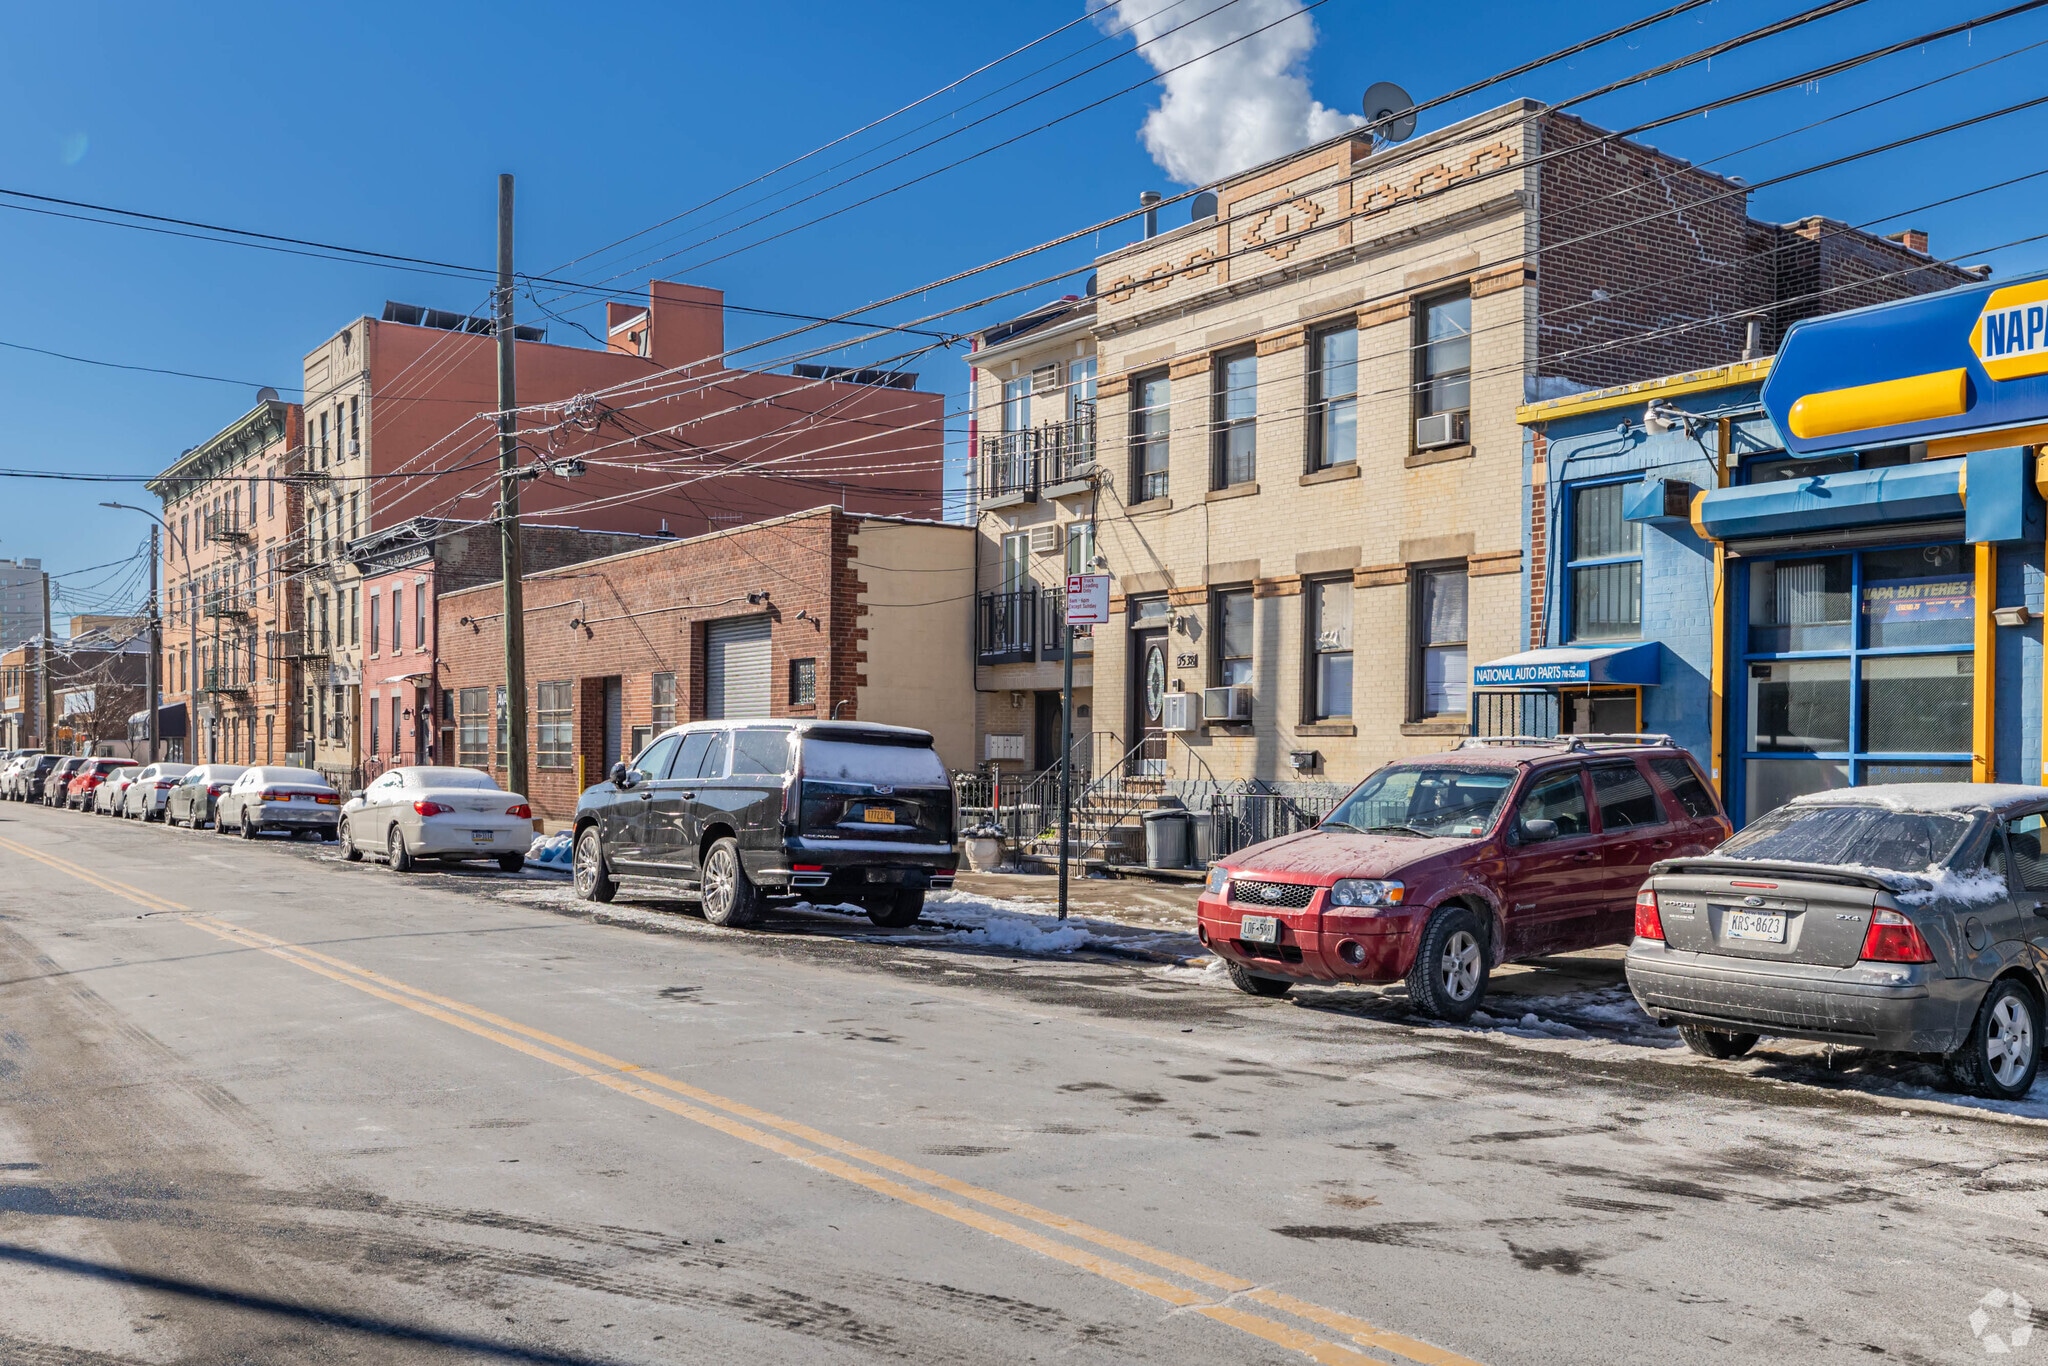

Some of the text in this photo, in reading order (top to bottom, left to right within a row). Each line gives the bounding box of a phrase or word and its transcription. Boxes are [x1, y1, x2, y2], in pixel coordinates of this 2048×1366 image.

[1986, 305, 2048, 357] NAP
[1862, 582, 1968, 600] NAPA BATTERIES
[1476, 669, 1513, 682] NATIONAL
[1515, 667, 1537, 680] AUTO
[1538, 666, 1561, 679] PARTS
[1731, 915, 1780, 934] KRS 8623
[1836, 913, 1861, 922] ZX4
